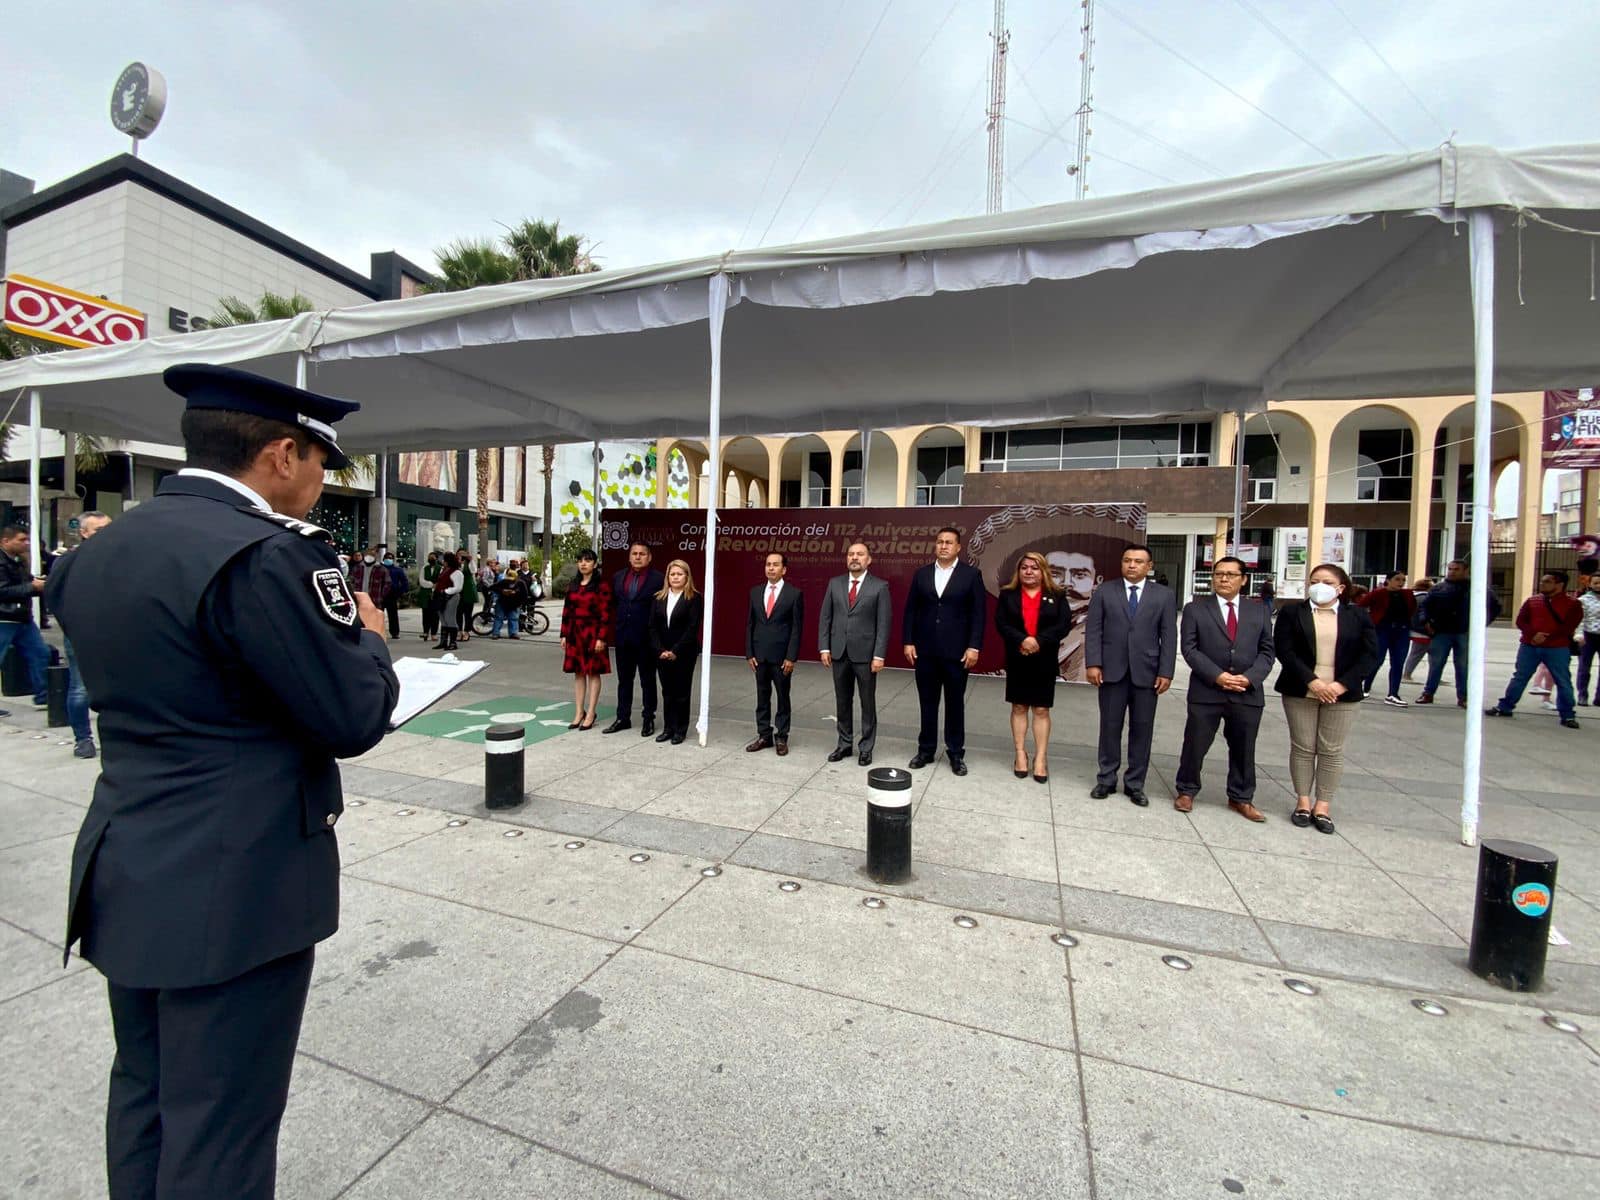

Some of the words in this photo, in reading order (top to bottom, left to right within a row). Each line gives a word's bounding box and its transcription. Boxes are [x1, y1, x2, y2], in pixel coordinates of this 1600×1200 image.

[10, 289, 140, 345] OXXO
[805, 523, 830, 536] del
[833, 523, 856, 536] 112
[678, 538, 697, 551] de
[718, 535, 835, 553] Revolución
